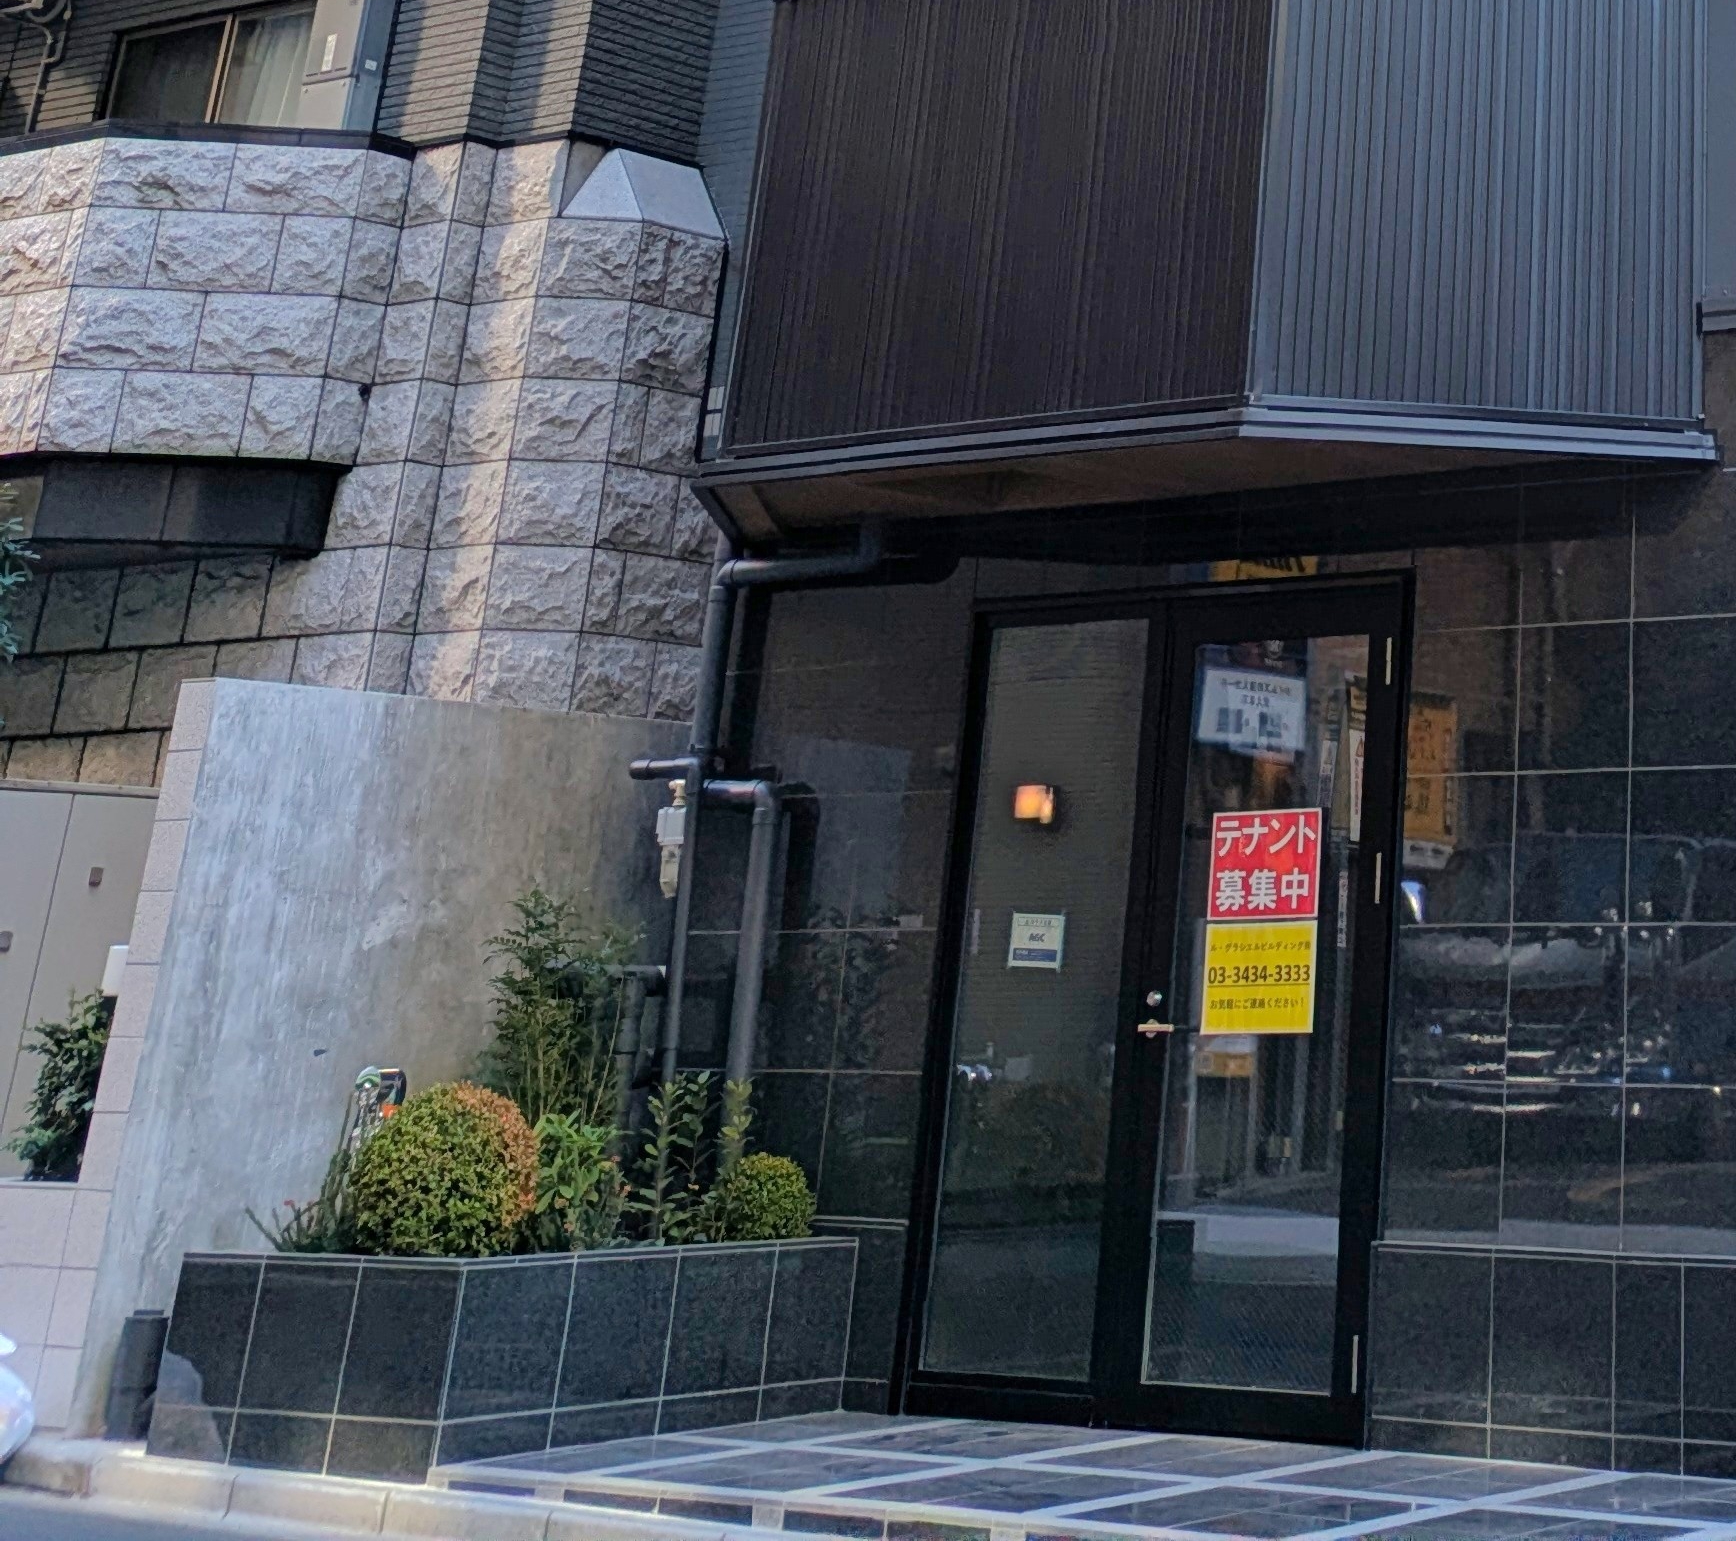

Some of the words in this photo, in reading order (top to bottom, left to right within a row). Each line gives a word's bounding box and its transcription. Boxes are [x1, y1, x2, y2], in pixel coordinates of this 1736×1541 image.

[1217, 815, 1316, 857] テナント
[1215, 867, 1310, 912] 募集中
[1208, 963, 1311, 985] 03-3434-3333
